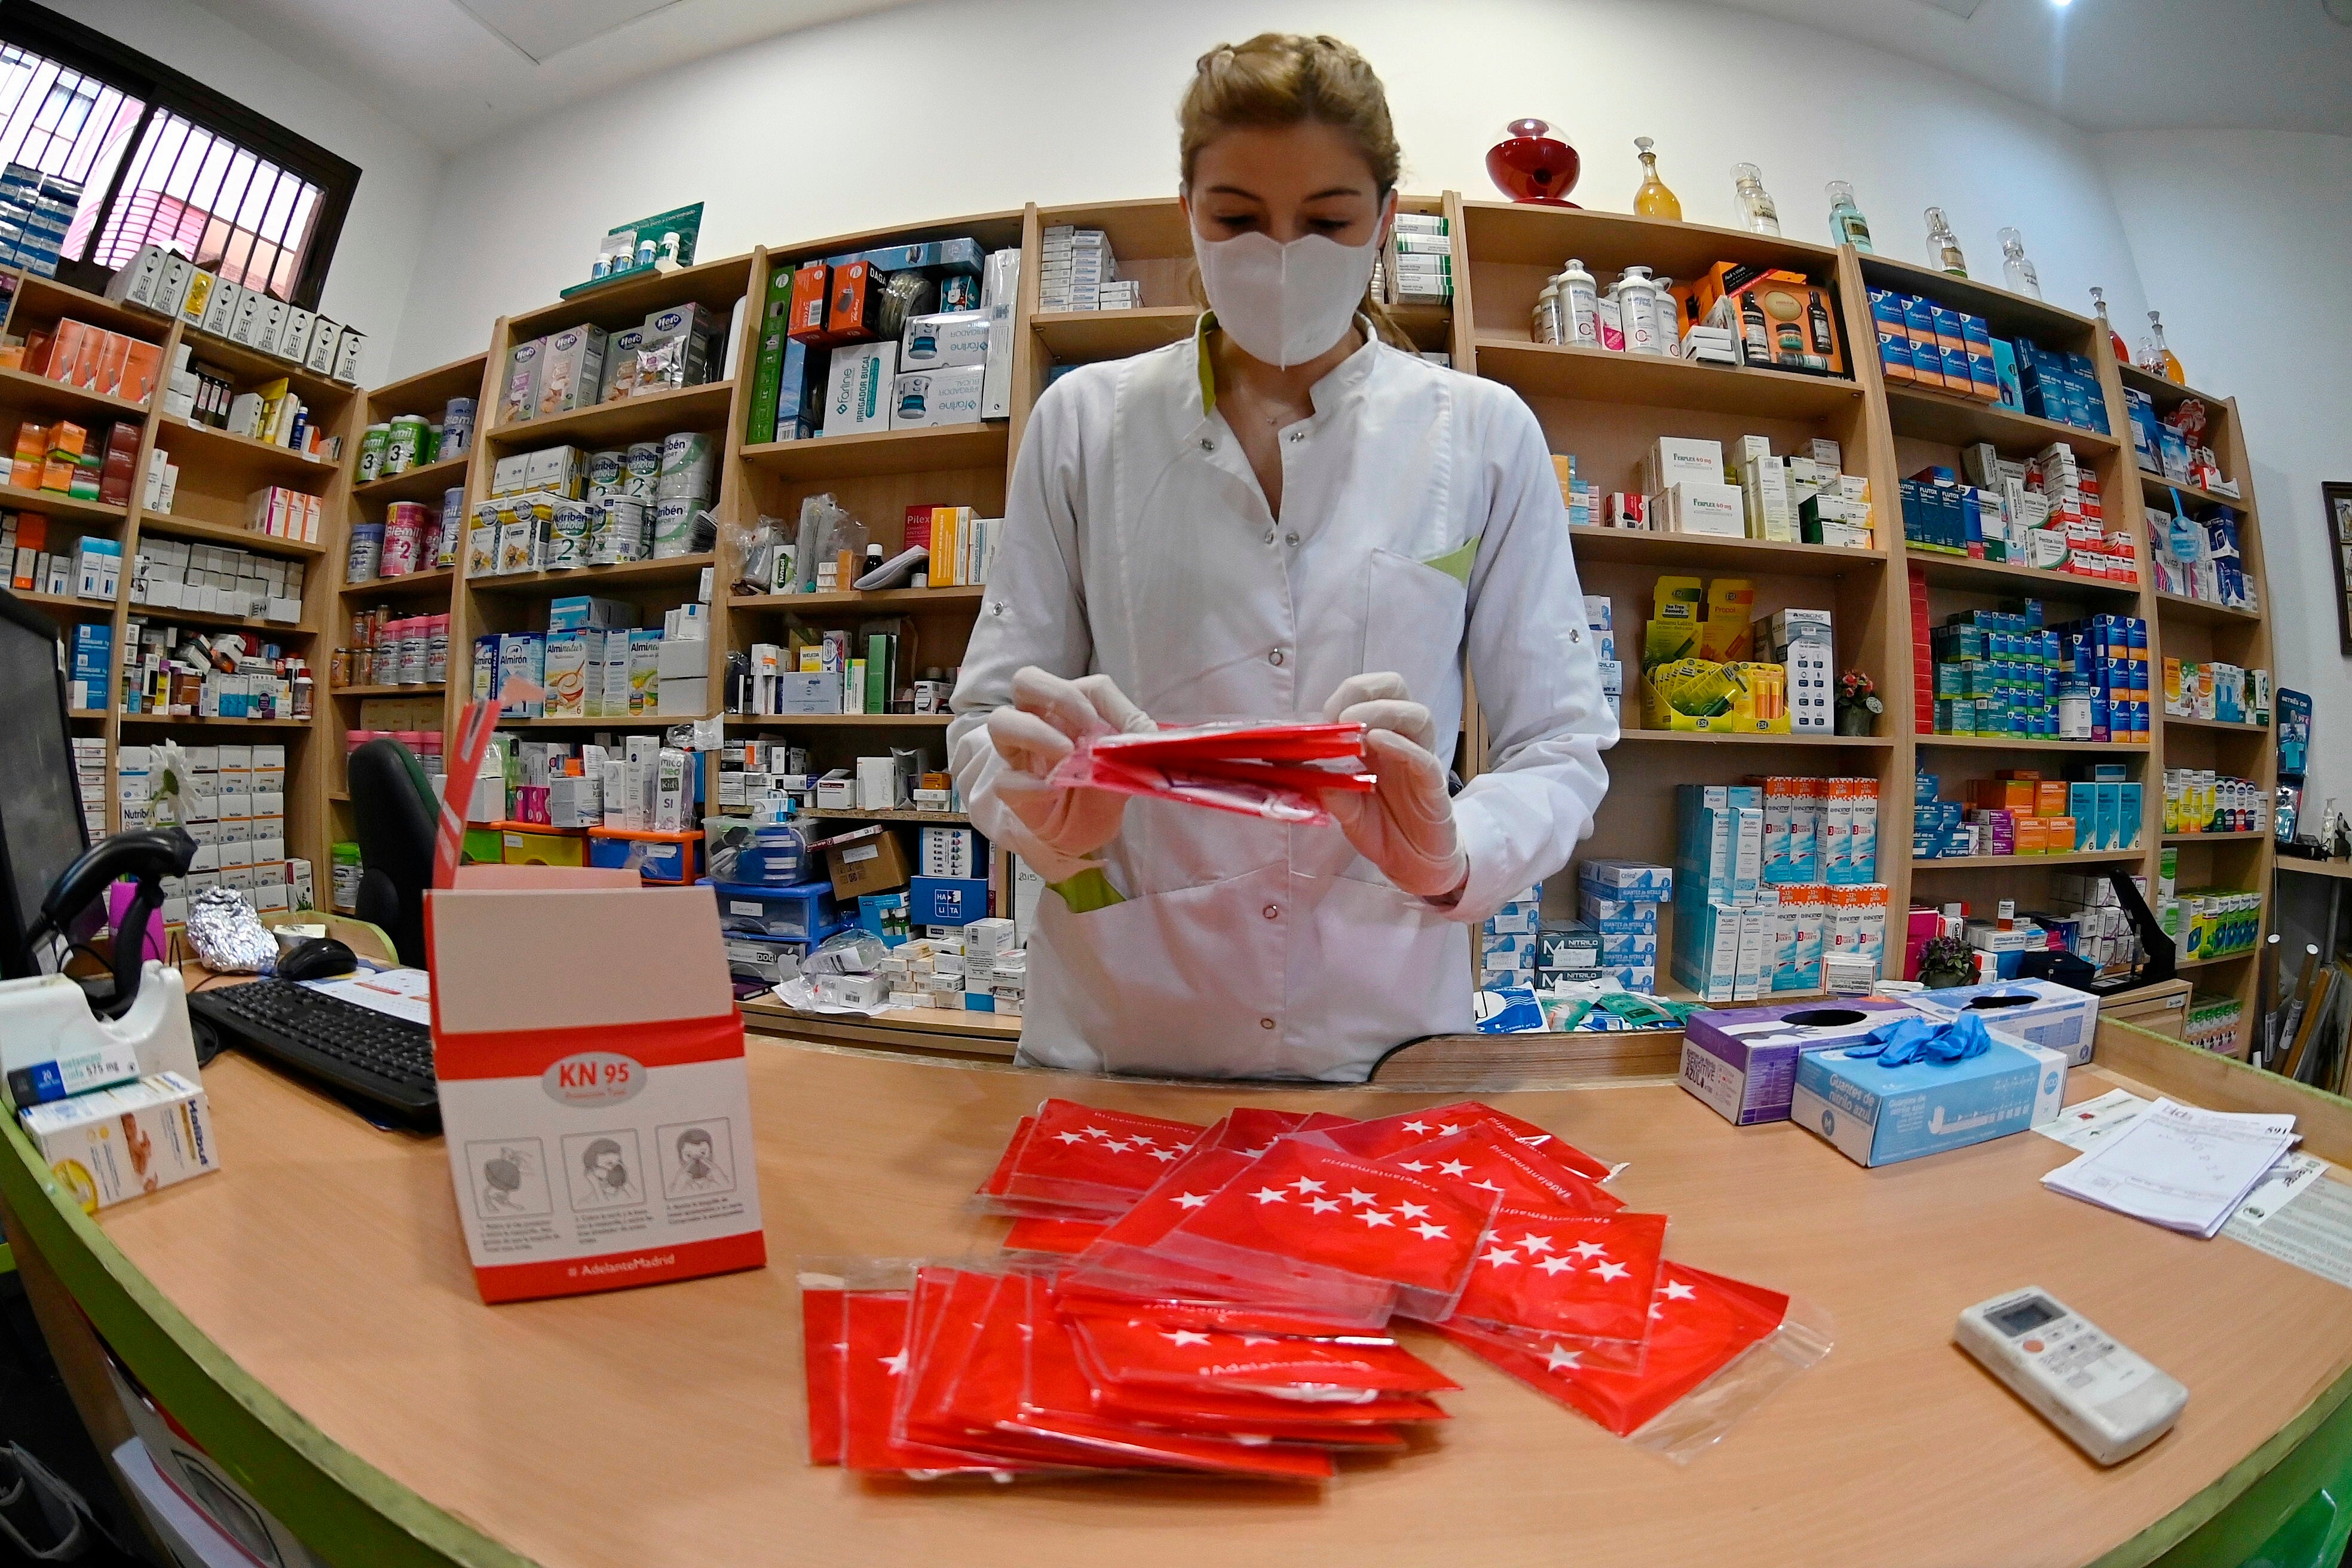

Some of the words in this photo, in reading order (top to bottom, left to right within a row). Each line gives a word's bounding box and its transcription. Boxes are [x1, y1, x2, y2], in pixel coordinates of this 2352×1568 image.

[869, 267, 887, 287] DAGA
[657, 314, 679, 326] Hero
[557, 335, 577, 347] Hero
[620, 333, 642, 346] Hero
[516, 348, 535, 359] Hero
[856, 380, 868, 423] IRRIGADOR
[862, 354, 871, 379] BUCAL
[456, 430, 464, 448] 1
[390, 445, 401, 461] 3
[1673, 453, 1695, 461] FERPLEX
[363, 454, 374, 470] 3
[632, 479, 645, 498] 2
[1919, 486, 1938, 495] FLUTOX
[1942, 491, 1959, 500] FLUTOX
[1693, 498, 1716, 508] FERPLEX
[906, 515, 930, 525] Pilex
[400, 541, 411, 559] 2
[558, 539, 574, 561] 2
[547, 643, 585, 654] Alminatur
[631, 643, 659, 653] Almina
[500, 655, 527, 664] Almirón
[664, 798, 673, 808] SI
[124, 808, 155, 819] Nutribn
[1543, 939, 1565, 954] M
[1542, 973, 1563, 988] M
[106, 1061, 120, 1072] mg
[1686, 1055, 1716, 1083] SENSITIVE
[560, 1061, 598, 1088] KN
[604, 1062, 630, 1083] 95
[1685, 1067, 1701, 1086] AZUL
[1829, 1073, 1862, 1101] Guantes
[1863, 1092, 1875, 1107] de
[1829, 1089, 1852, 1113] nitrilo
[1853, 1104, 1872, 1123] azul
[1500, 1206, 1612, 1224] #Adelantemadri
[581, 1253, 676, 1277] AdelanteMadrid
